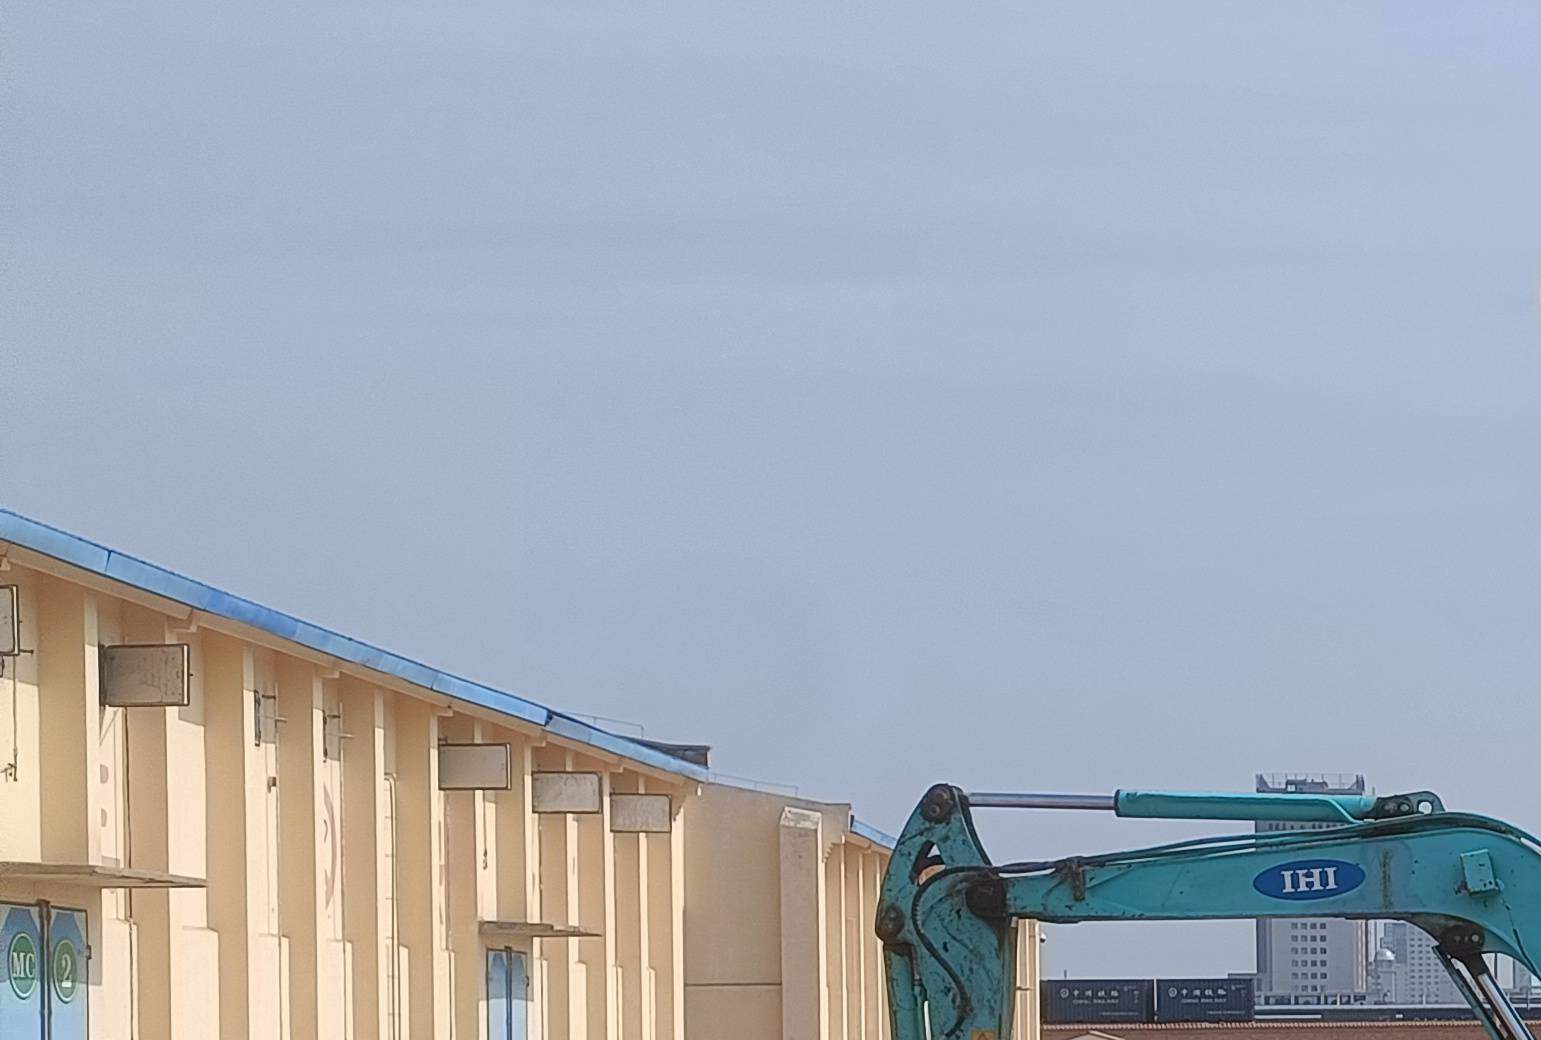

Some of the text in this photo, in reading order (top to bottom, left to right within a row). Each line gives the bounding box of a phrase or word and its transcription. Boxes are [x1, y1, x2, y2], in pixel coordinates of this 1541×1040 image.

[1280, 866, 1339, 893] IHI
[12, 951, 73, 988] MC 2
